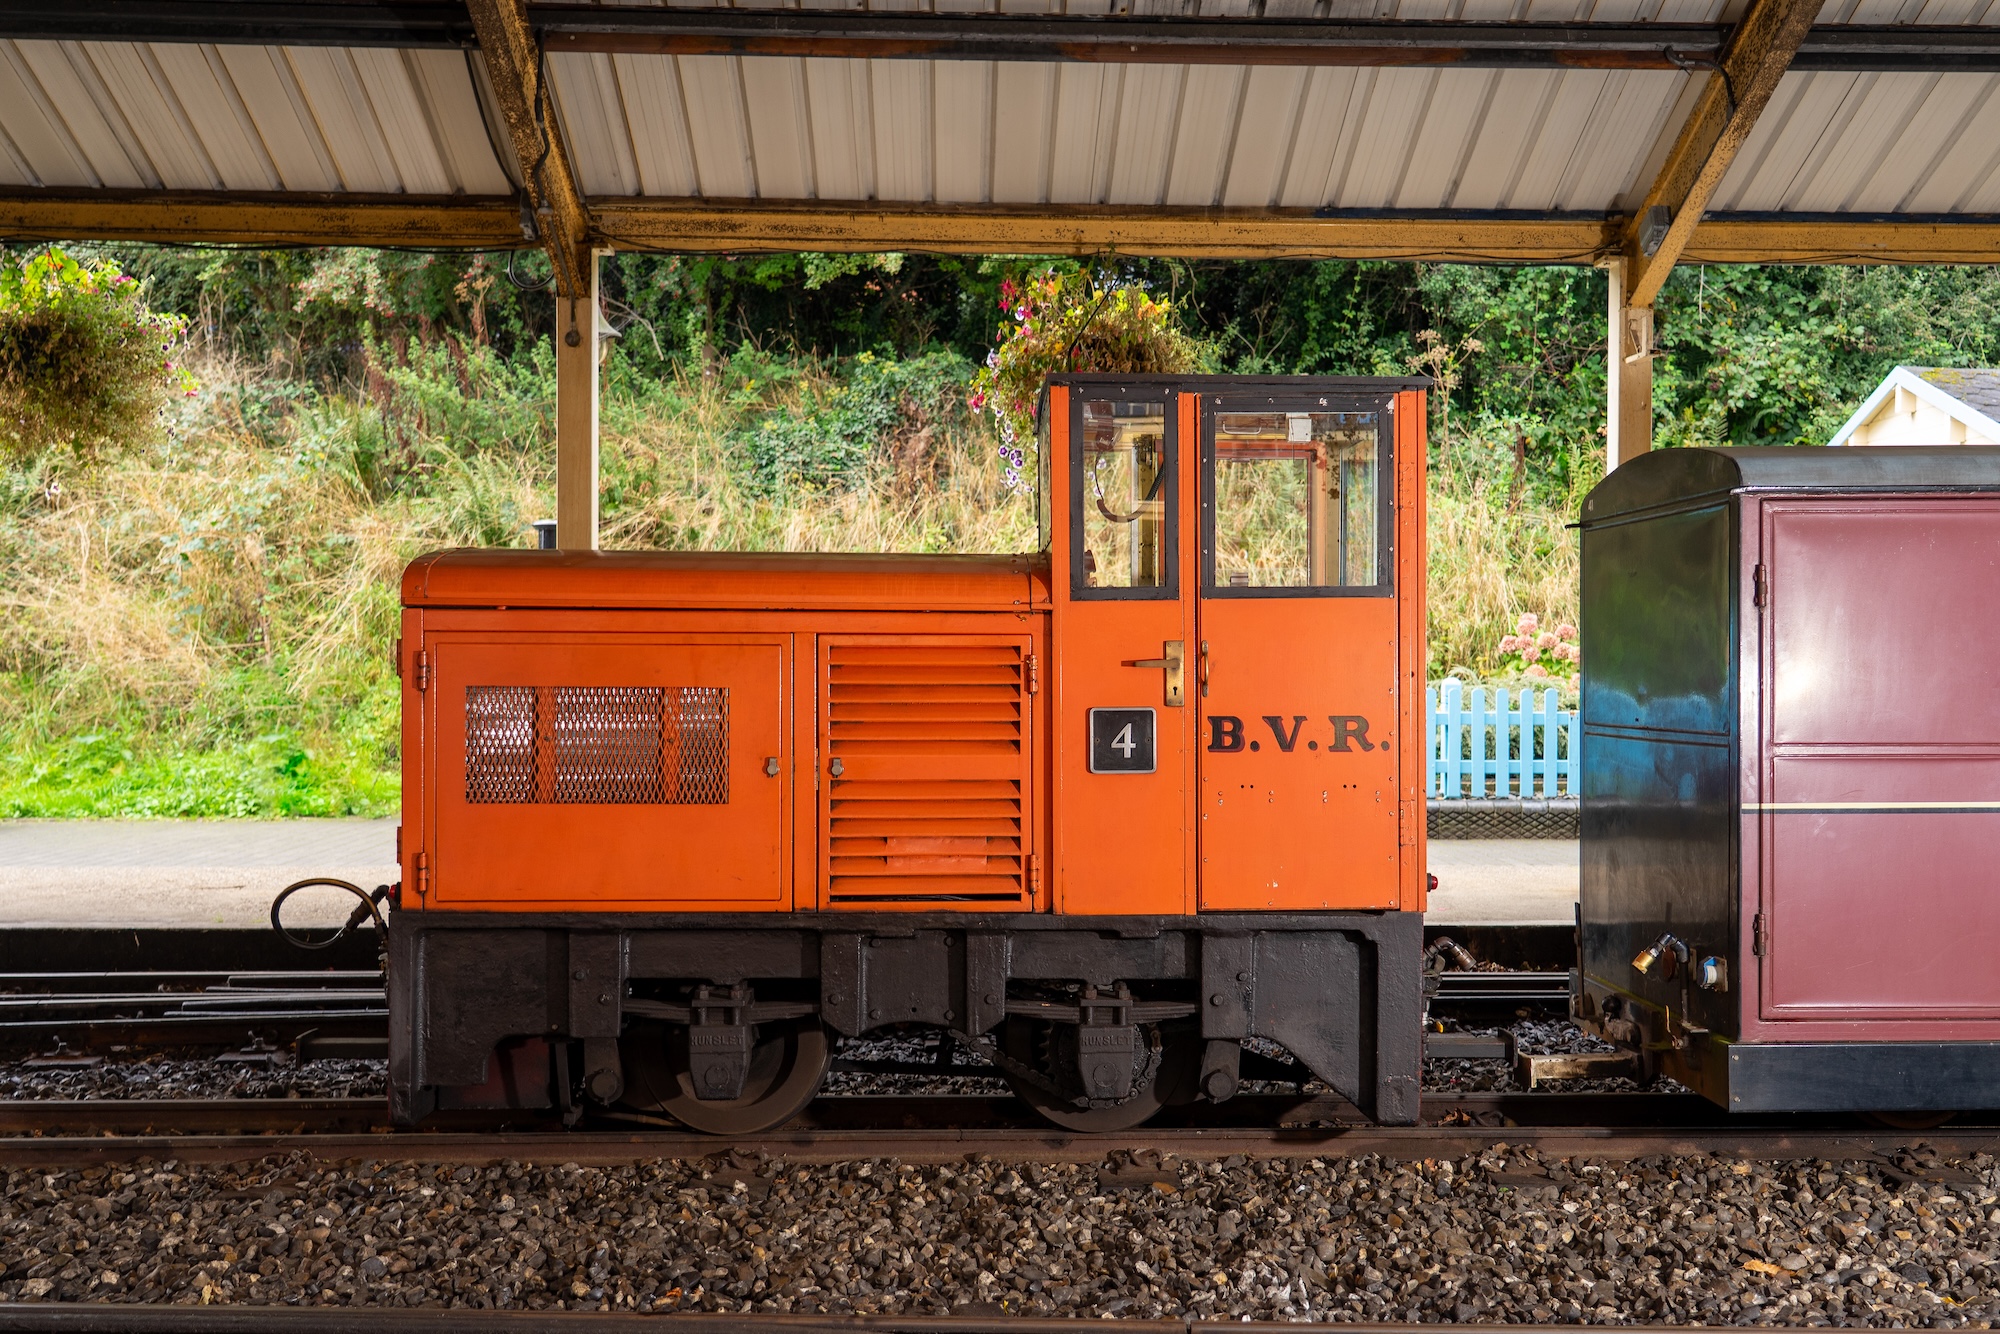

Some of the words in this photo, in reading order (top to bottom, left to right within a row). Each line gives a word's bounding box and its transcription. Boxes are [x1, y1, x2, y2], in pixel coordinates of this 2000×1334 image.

[1110, 722, 1137, 758] 4
[1207, 716, 1390, 752] B.V.R.
[691, 1035, 742, 1046] HUNSLET
[1081, 1035, 1132, 1046] HUNSLET
